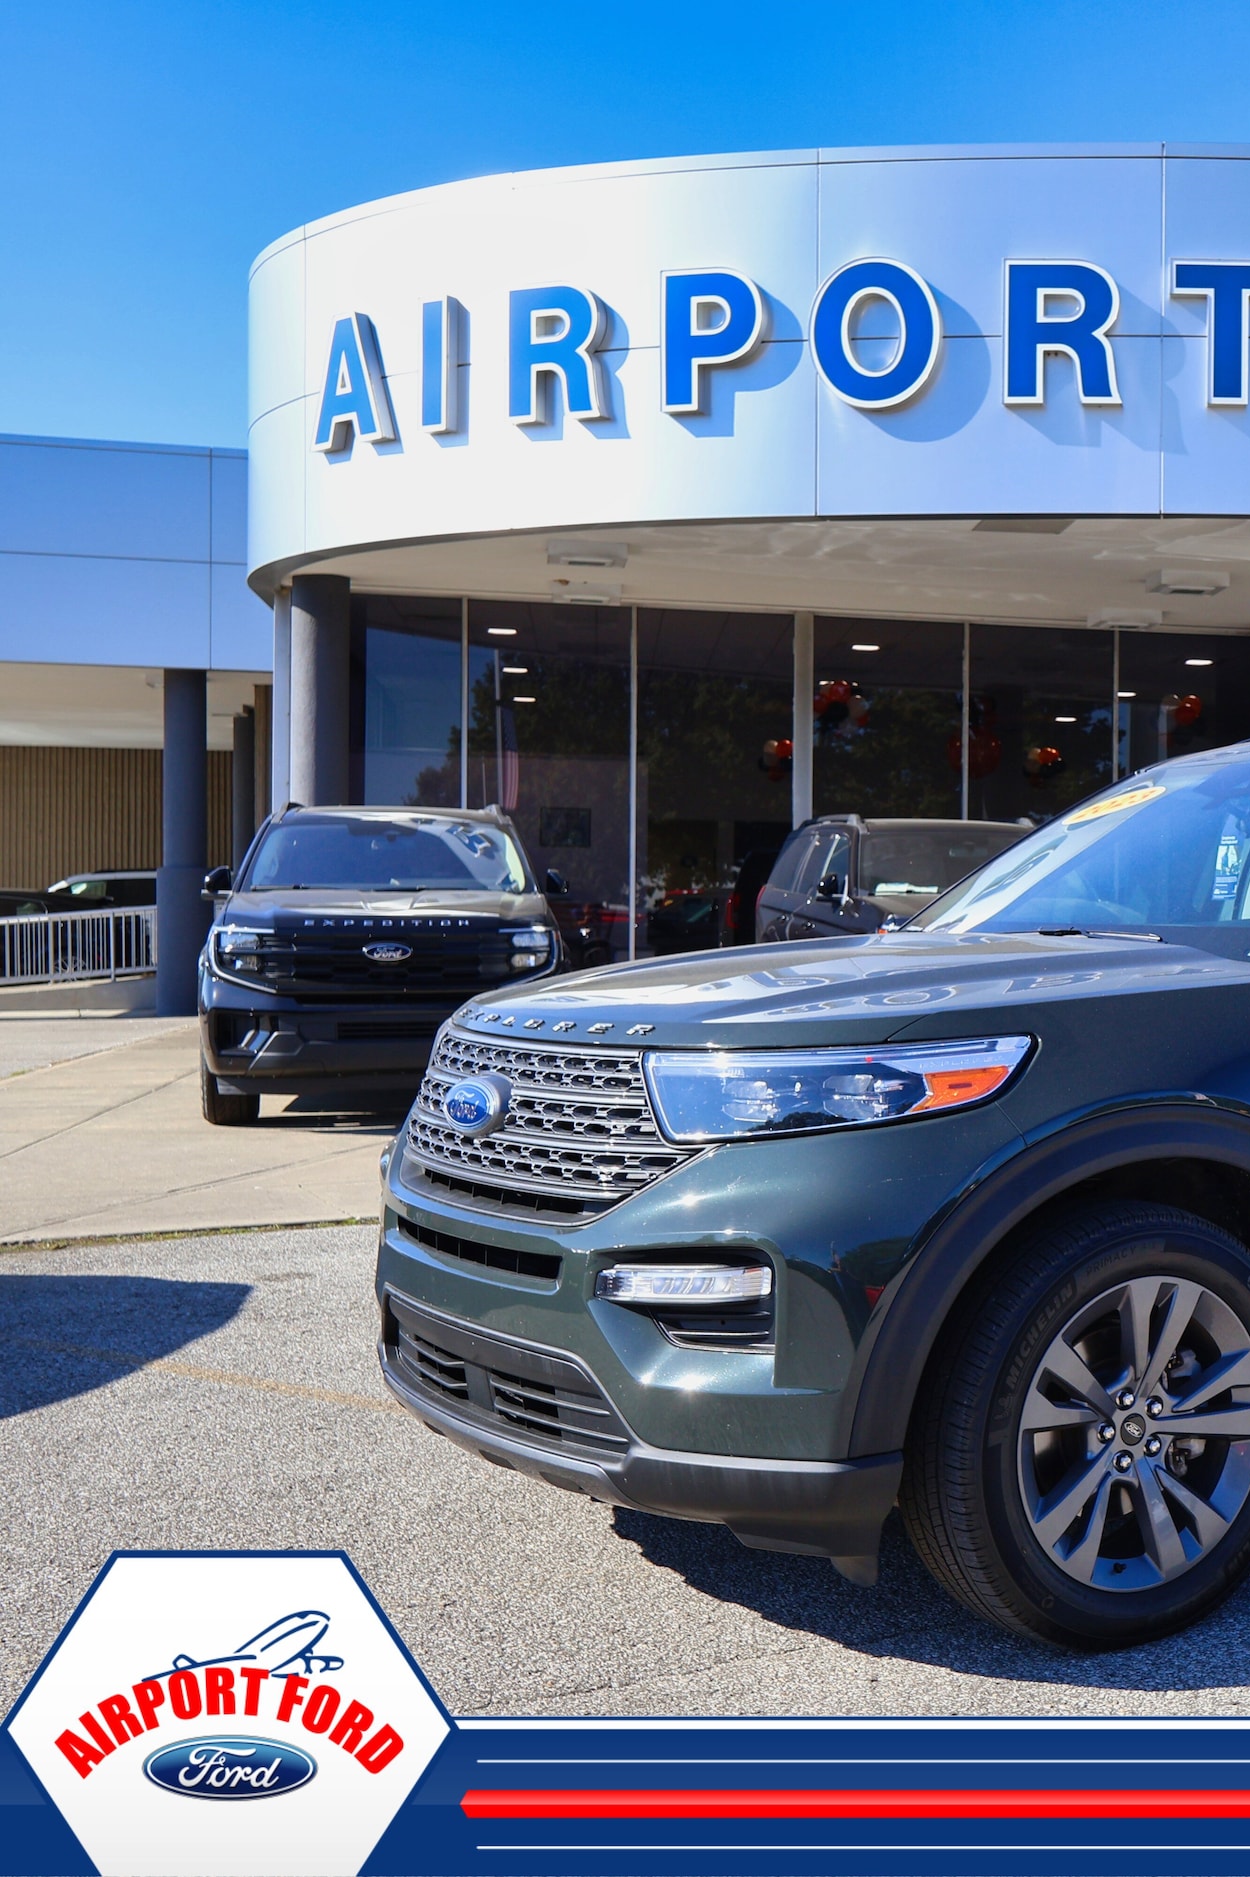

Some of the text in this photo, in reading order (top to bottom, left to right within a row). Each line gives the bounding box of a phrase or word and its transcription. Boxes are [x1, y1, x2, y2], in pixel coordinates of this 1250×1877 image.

[304, 919, 470, 927] EXPEDITION
[373, 946, 403, 959] Ford
[459, 1008, 656, 1036] EXPLORER
[449, 1089, 480, 1120] Ford
[1006, 1244, 1137, 1390] MICHELIN PRIMACY
